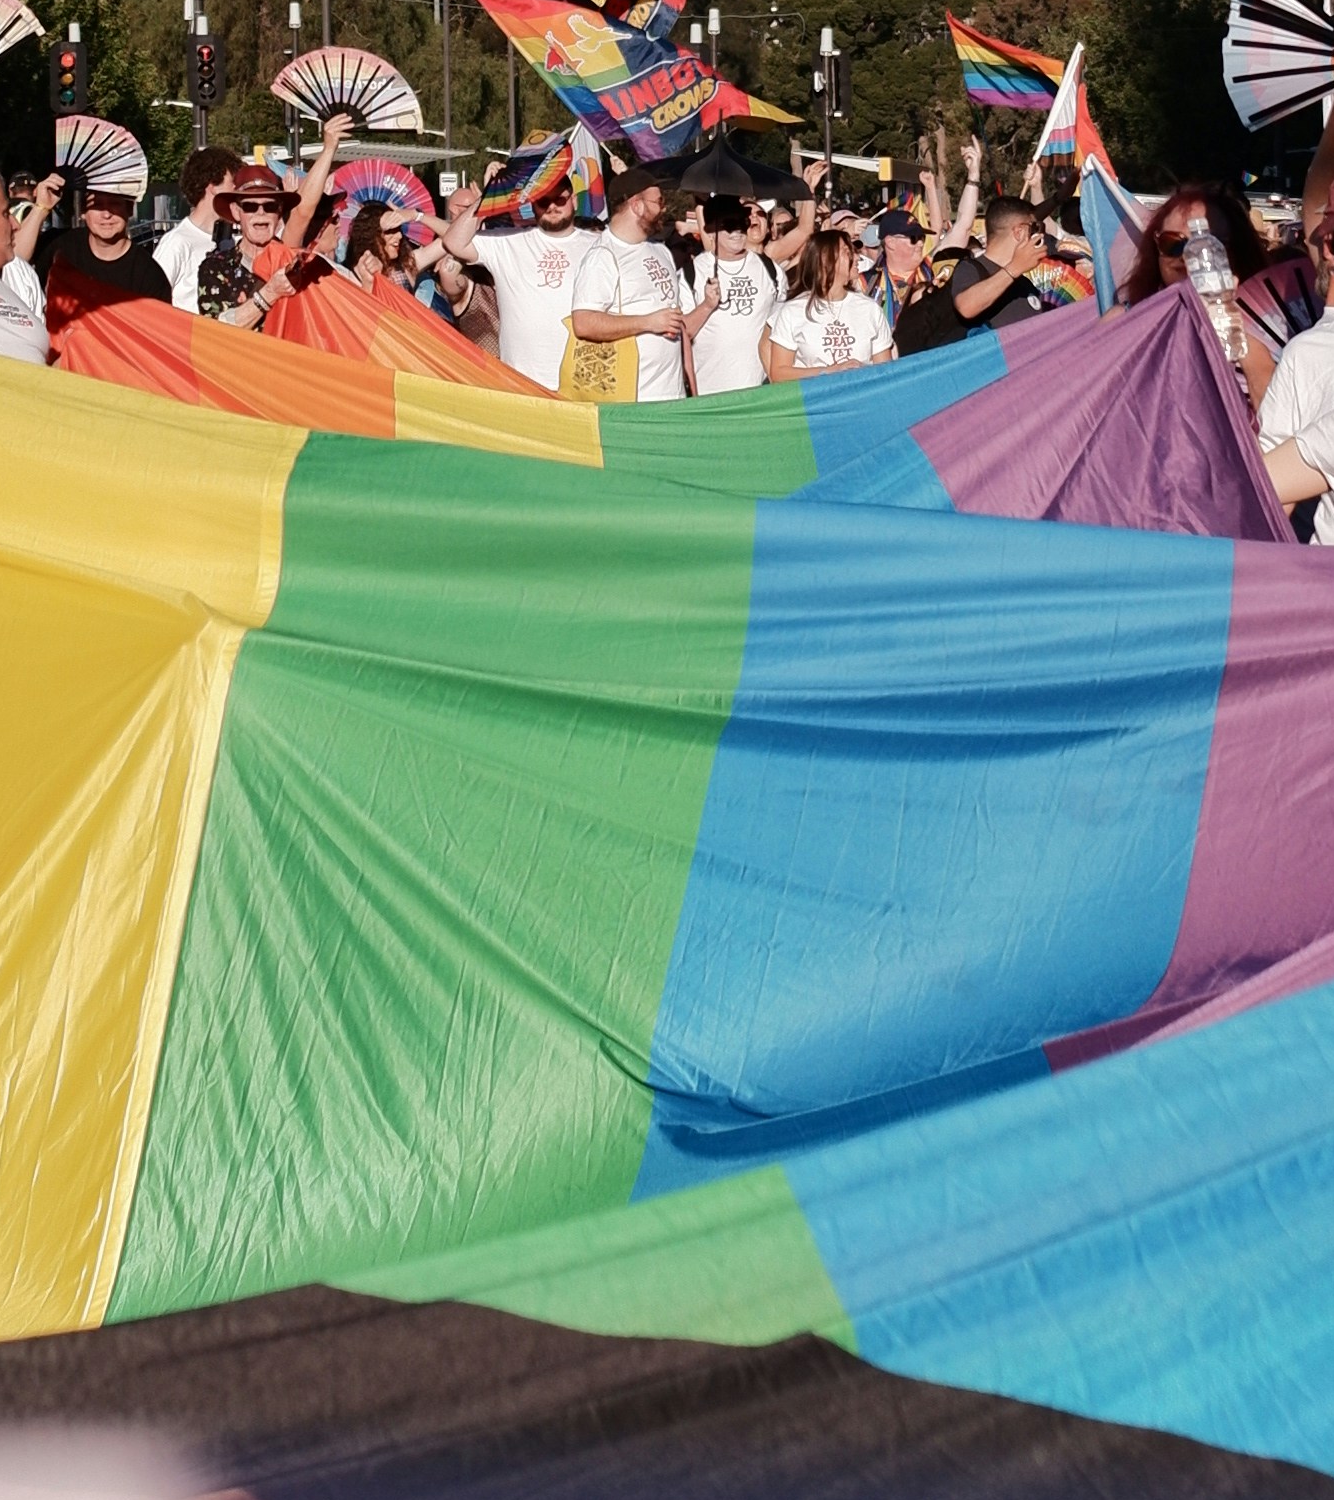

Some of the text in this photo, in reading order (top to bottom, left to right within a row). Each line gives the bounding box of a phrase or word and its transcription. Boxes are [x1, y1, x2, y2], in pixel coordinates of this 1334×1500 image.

[650, 77, 715, 130] CROWS
[825, 326, 850, 336] NOT
[822, 336, 856, 347] DEAD
